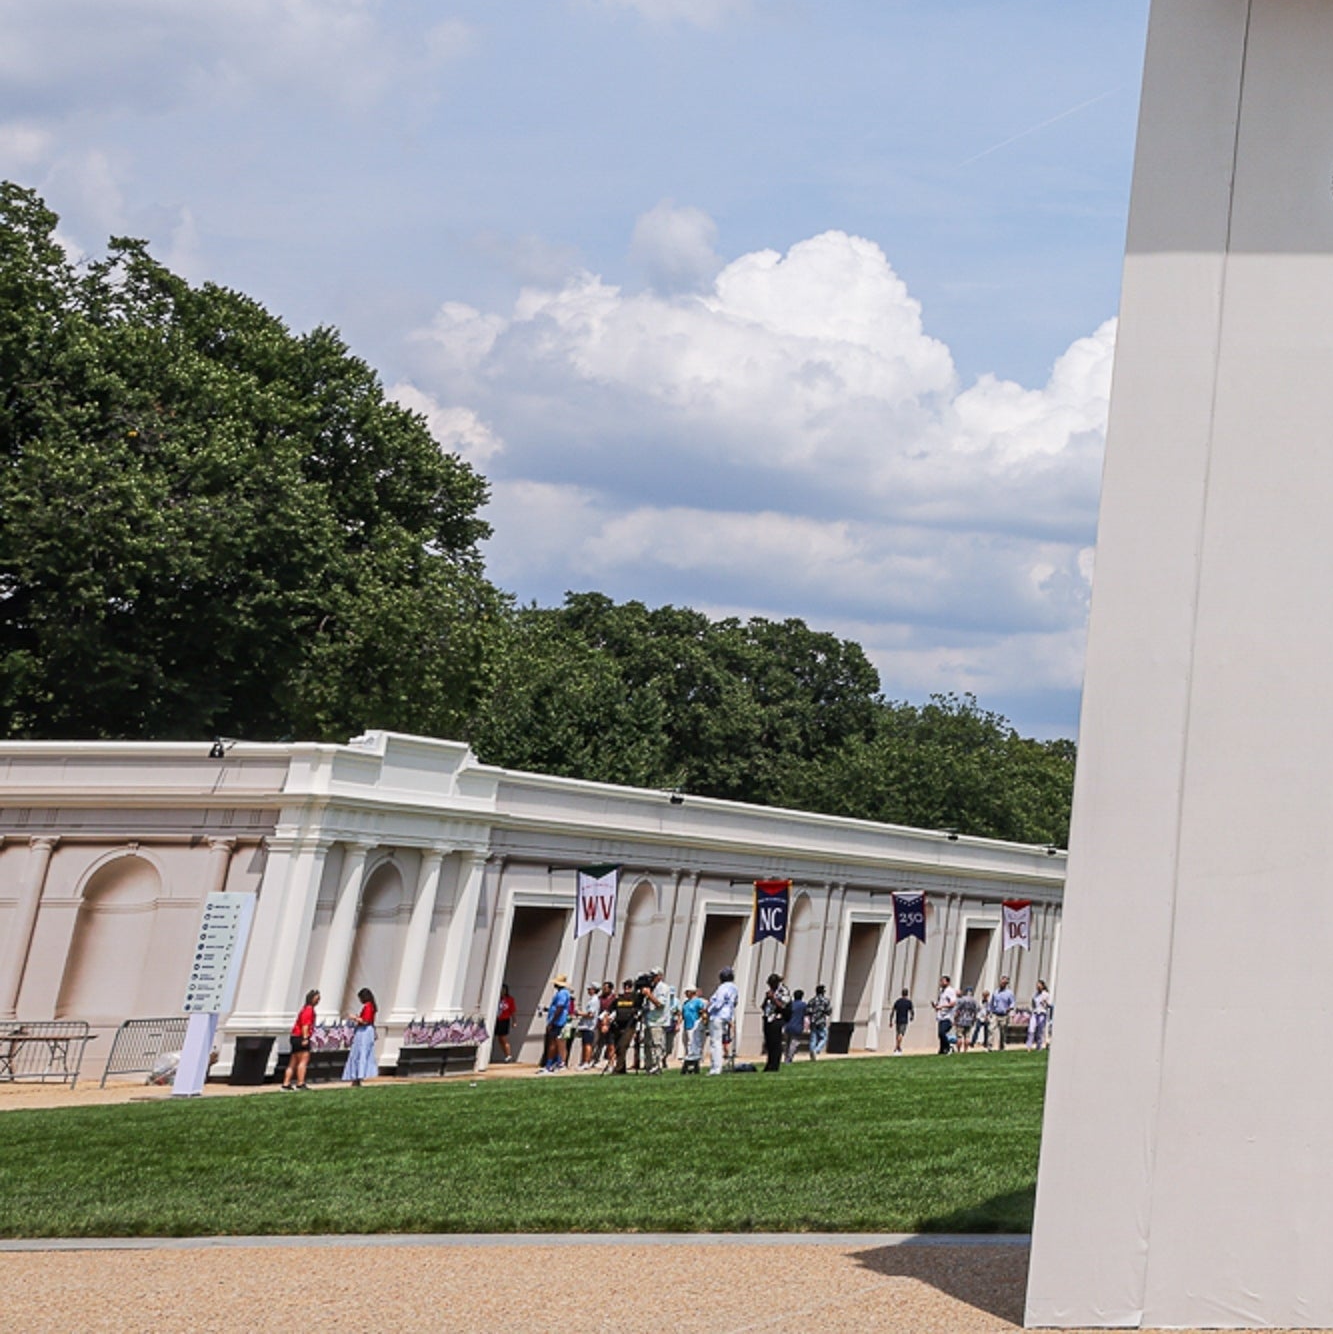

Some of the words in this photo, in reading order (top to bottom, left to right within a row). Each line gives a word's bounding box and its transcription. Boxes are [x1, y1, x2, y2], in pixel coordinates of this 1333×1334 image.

[582, 895, 614, 921] WV
[759, 907, 783, 931] NC
[899, 912, 923, 927] 250
[1009, 921, 1027, 939] DC
